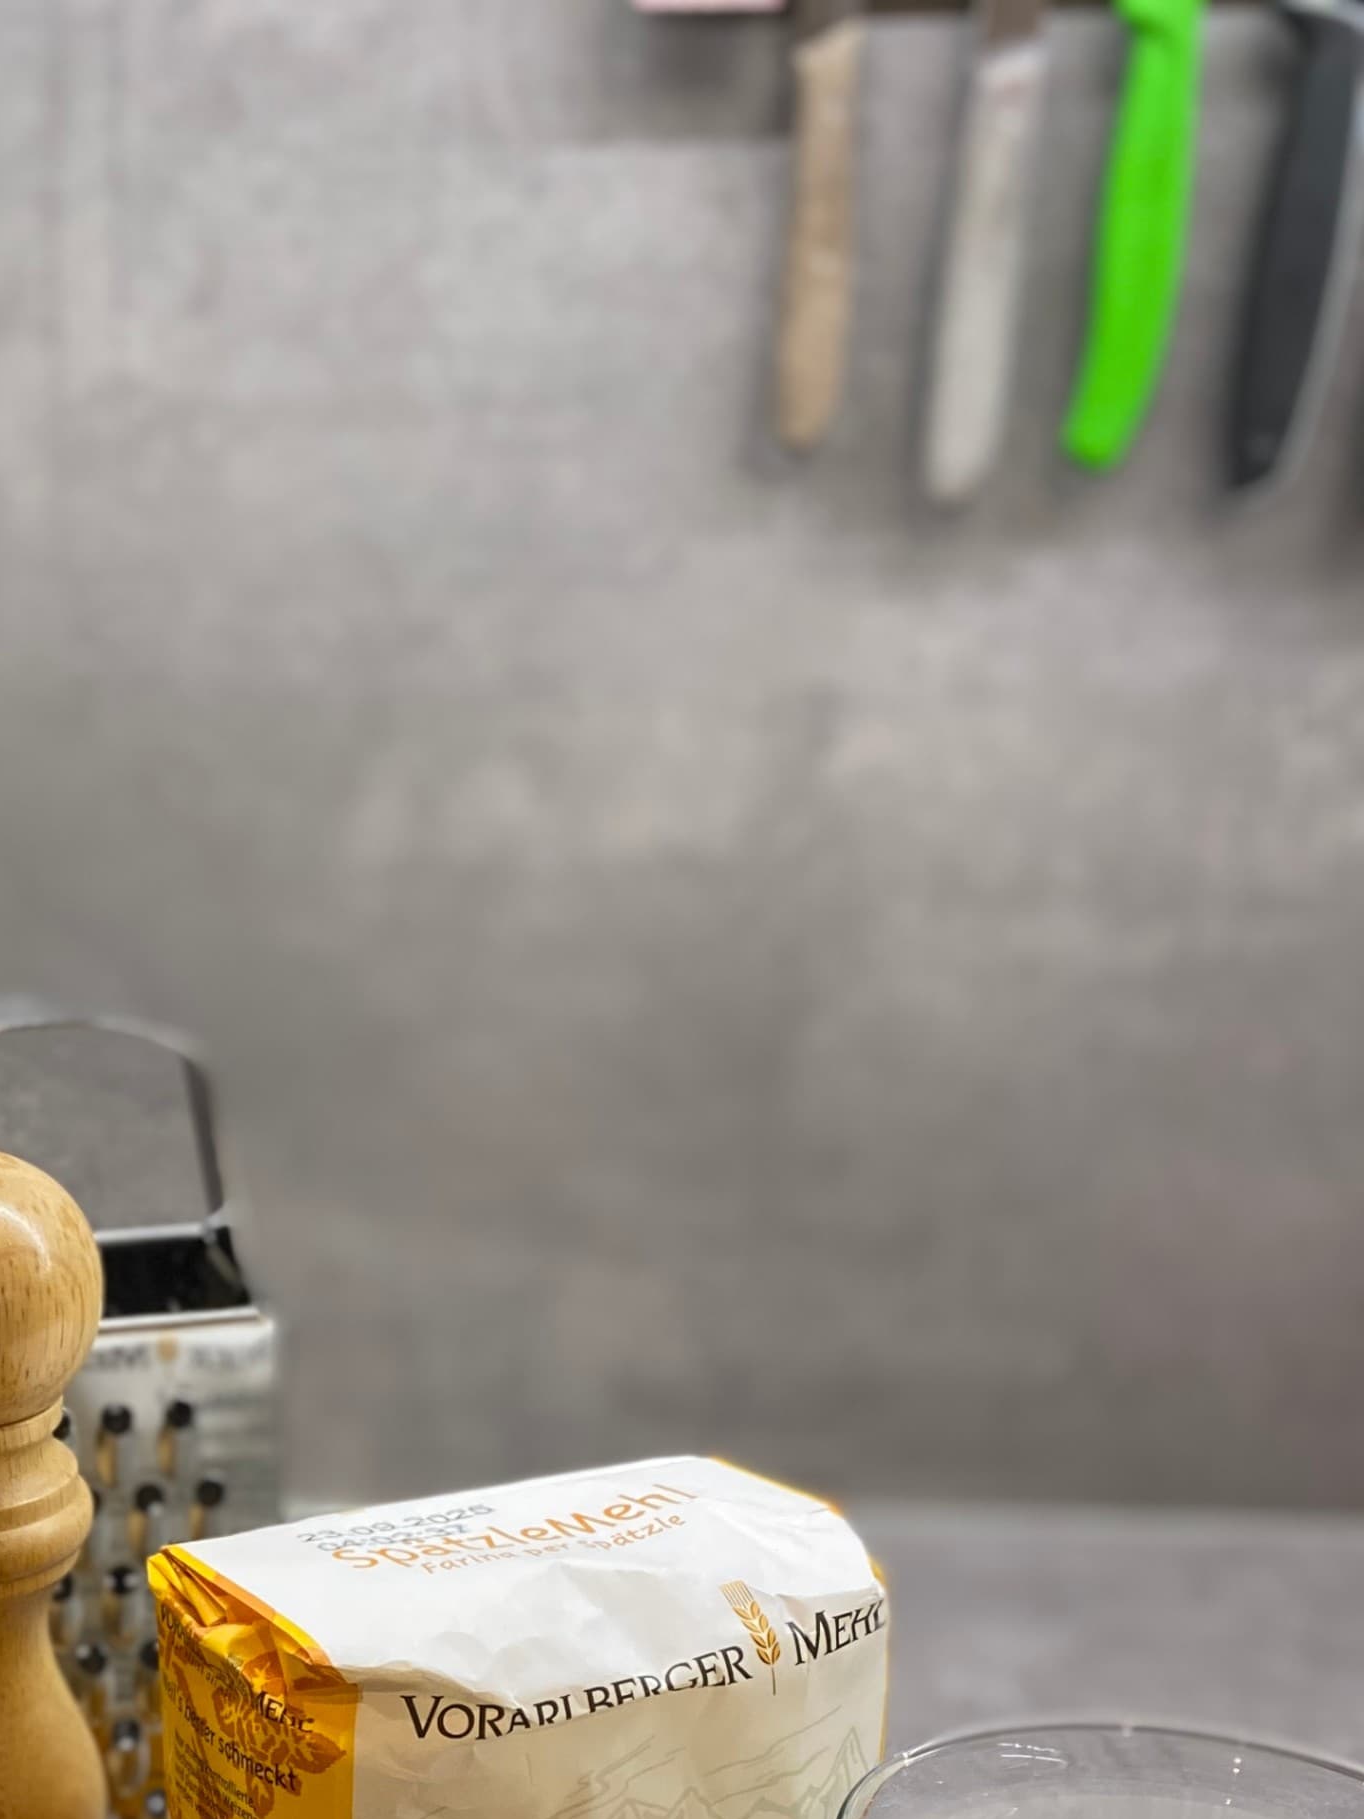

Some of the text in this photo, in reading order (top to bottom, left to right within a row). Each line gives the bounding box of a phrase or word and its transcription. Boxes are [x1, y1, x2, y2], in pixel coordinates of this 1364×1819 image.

[332, 1483, 698, 1568] SpätzleMehl
[422, 1551, 516, 1574] Farina
[218, 1737, 300, 1792] schmeckt
